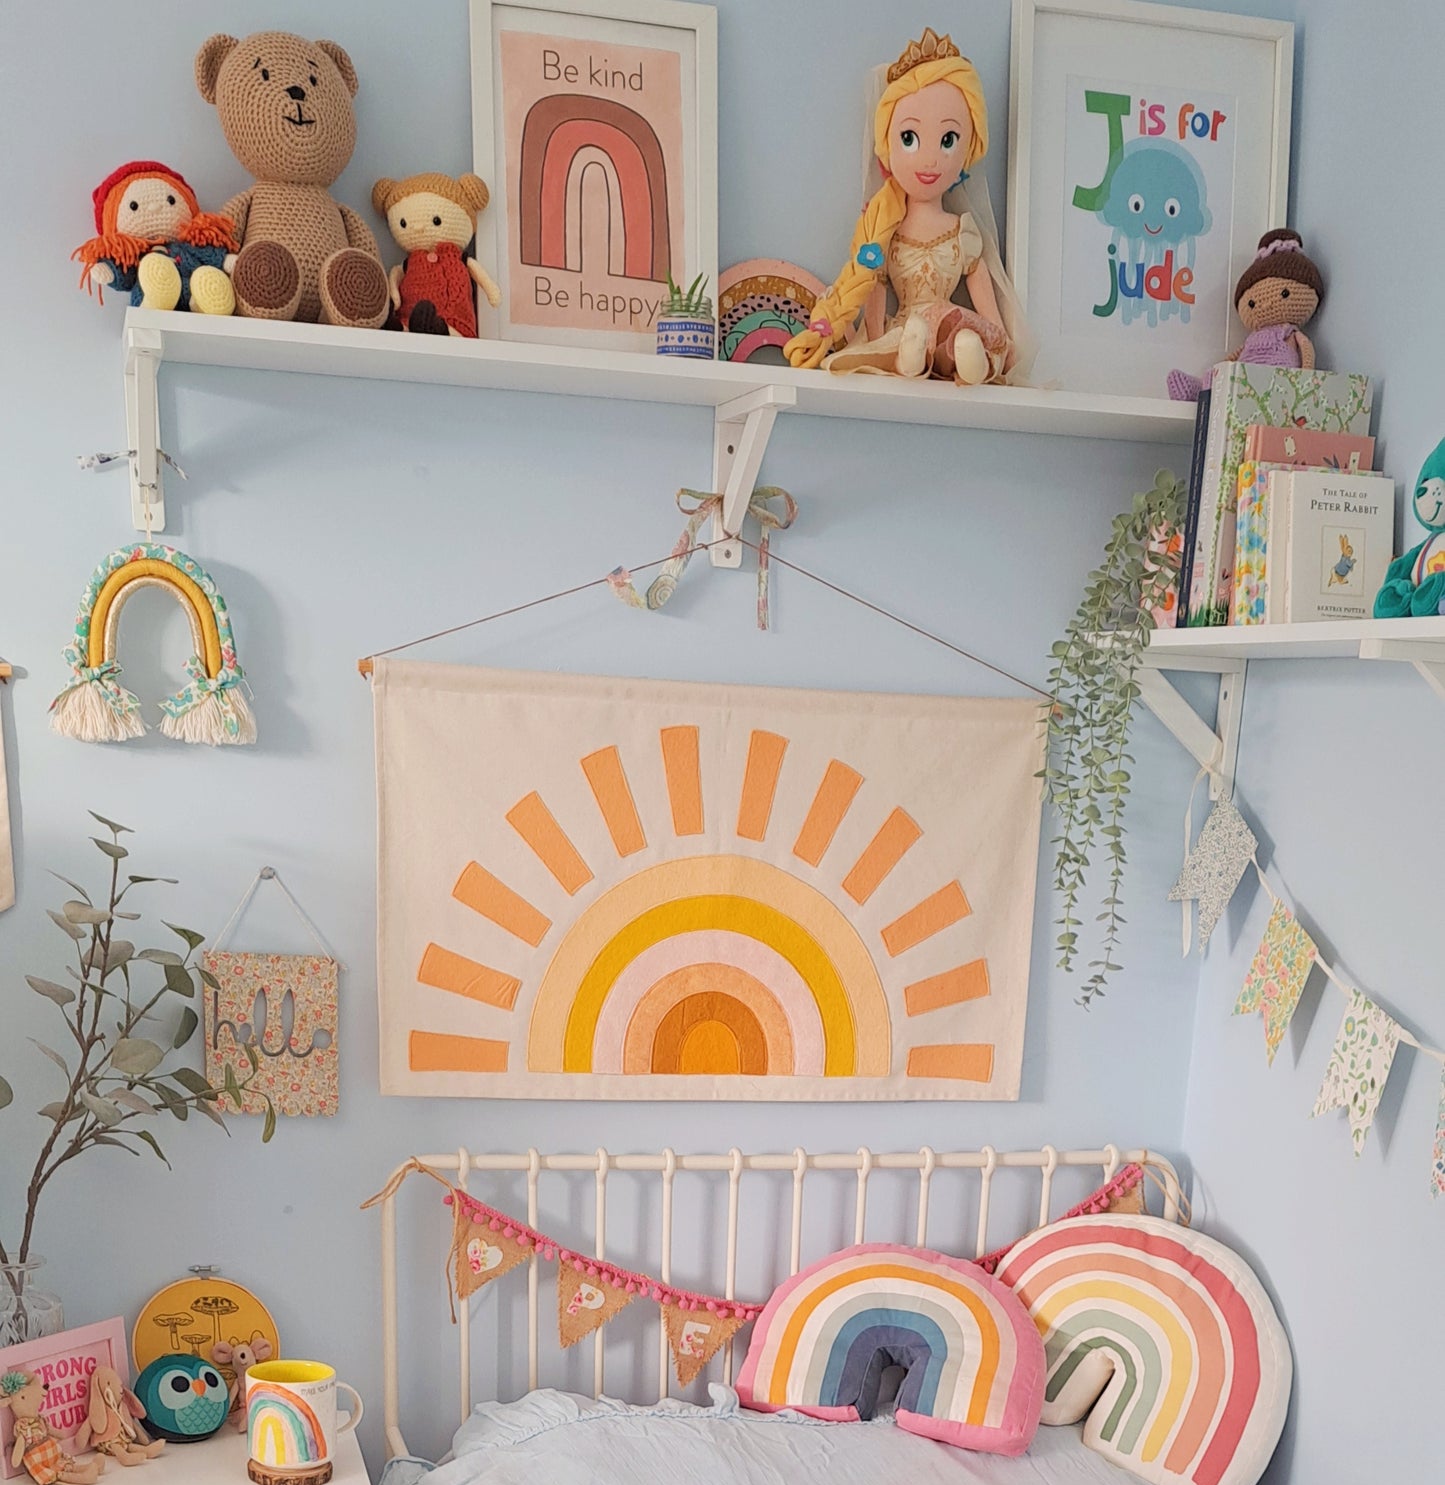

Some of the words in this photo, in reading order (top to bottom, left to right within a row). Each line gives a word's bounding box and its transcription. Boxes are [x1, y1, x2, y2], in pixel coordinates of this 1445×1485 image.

[543, 49, 579, 83] Be
[589, 55, 644, 92] kind
[1072, 90, 1131, 212] J
[1139, 98, 1166, 136] is
[1178, 103, 1227, 141] for
[1092, 243, 1196, 318] jude
[534, 276, 570, 308] Be
[579, 281, 660, 327] happy
[1209, 408, 1220, 463] Secret
[1310, 499, 1341, 512] PETER
[1343, 501, 1379, 515] RABBIT
[1339, 489, 1357, 498] TALE
[33, 1356, 97, 1385] RONG
[38, 1379, 87, 1412] IRLS
[45, 1404, 88, 1430] LUB
